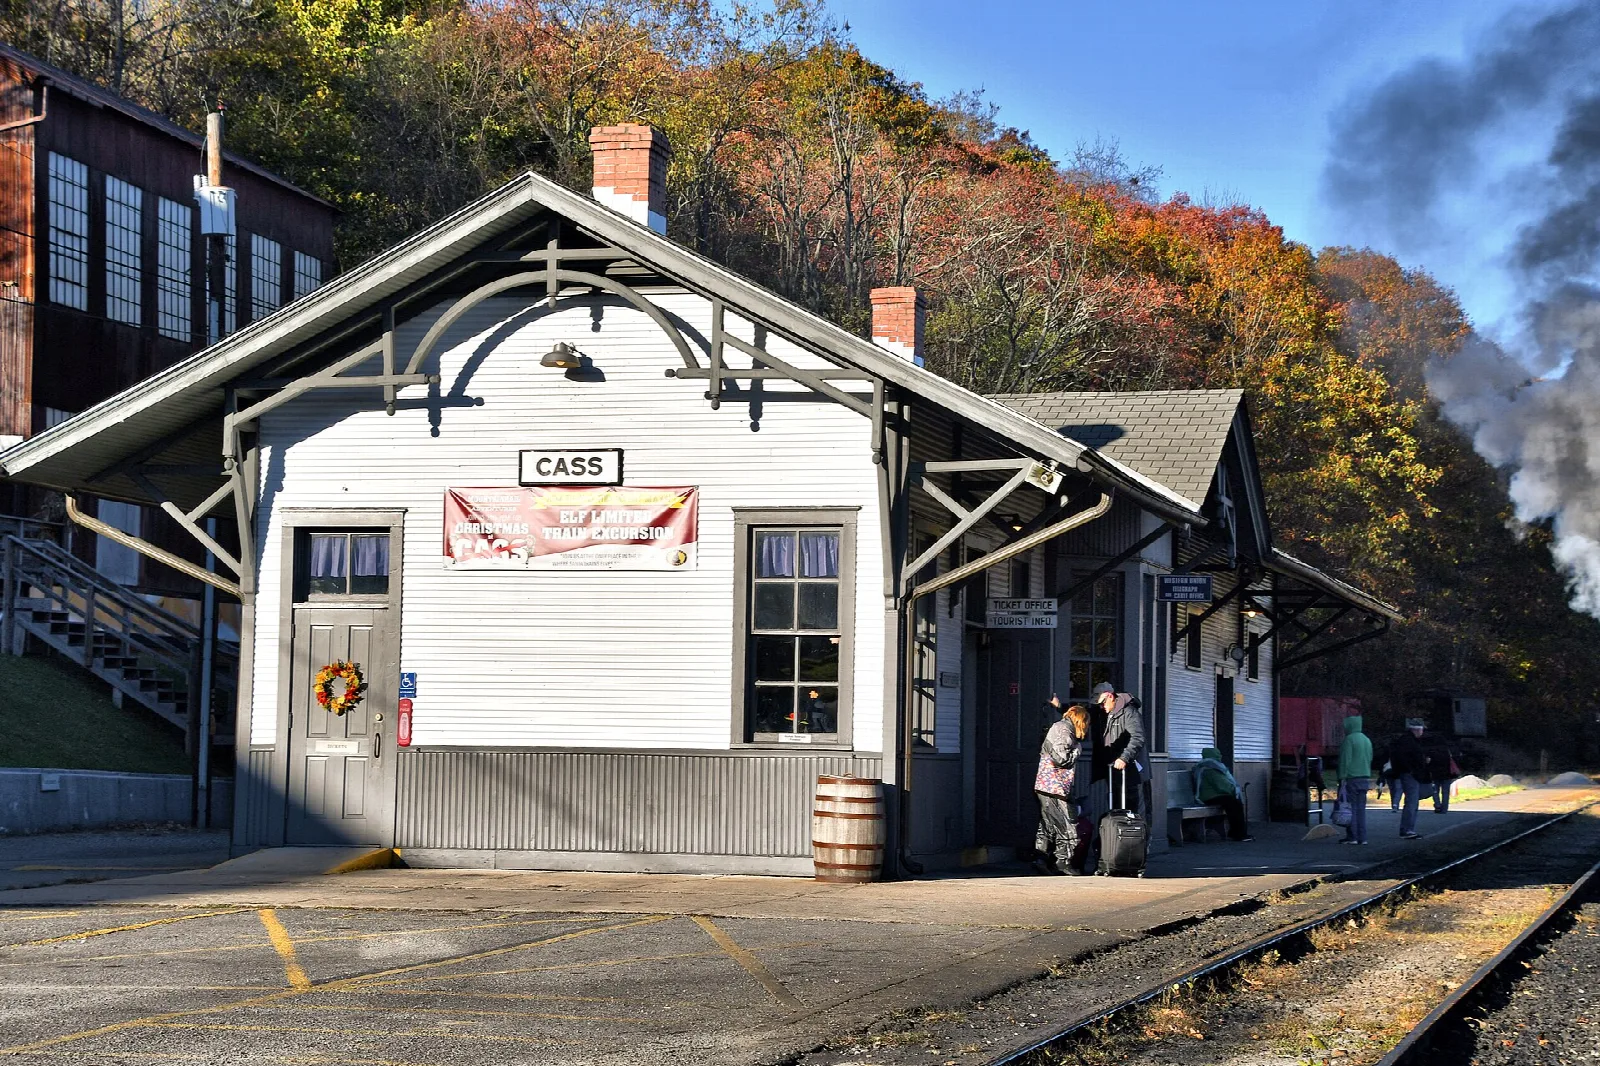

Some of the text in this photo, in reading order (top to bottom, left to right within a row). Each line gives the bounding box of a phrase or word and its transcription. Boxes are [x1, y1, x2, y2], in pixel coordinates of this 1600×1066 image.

[536, 457, 604, 477] CASS
[560, 509, 653, 524] ELF LIMITED
[455, 522, 529, 534] CHRISTMAS
[541, 527, 675, 540] TRAIN EXCURSION
[993, 600, 1053, 610] TICKET OFFICE
[993, 617, 1027, 626] TOURIST
